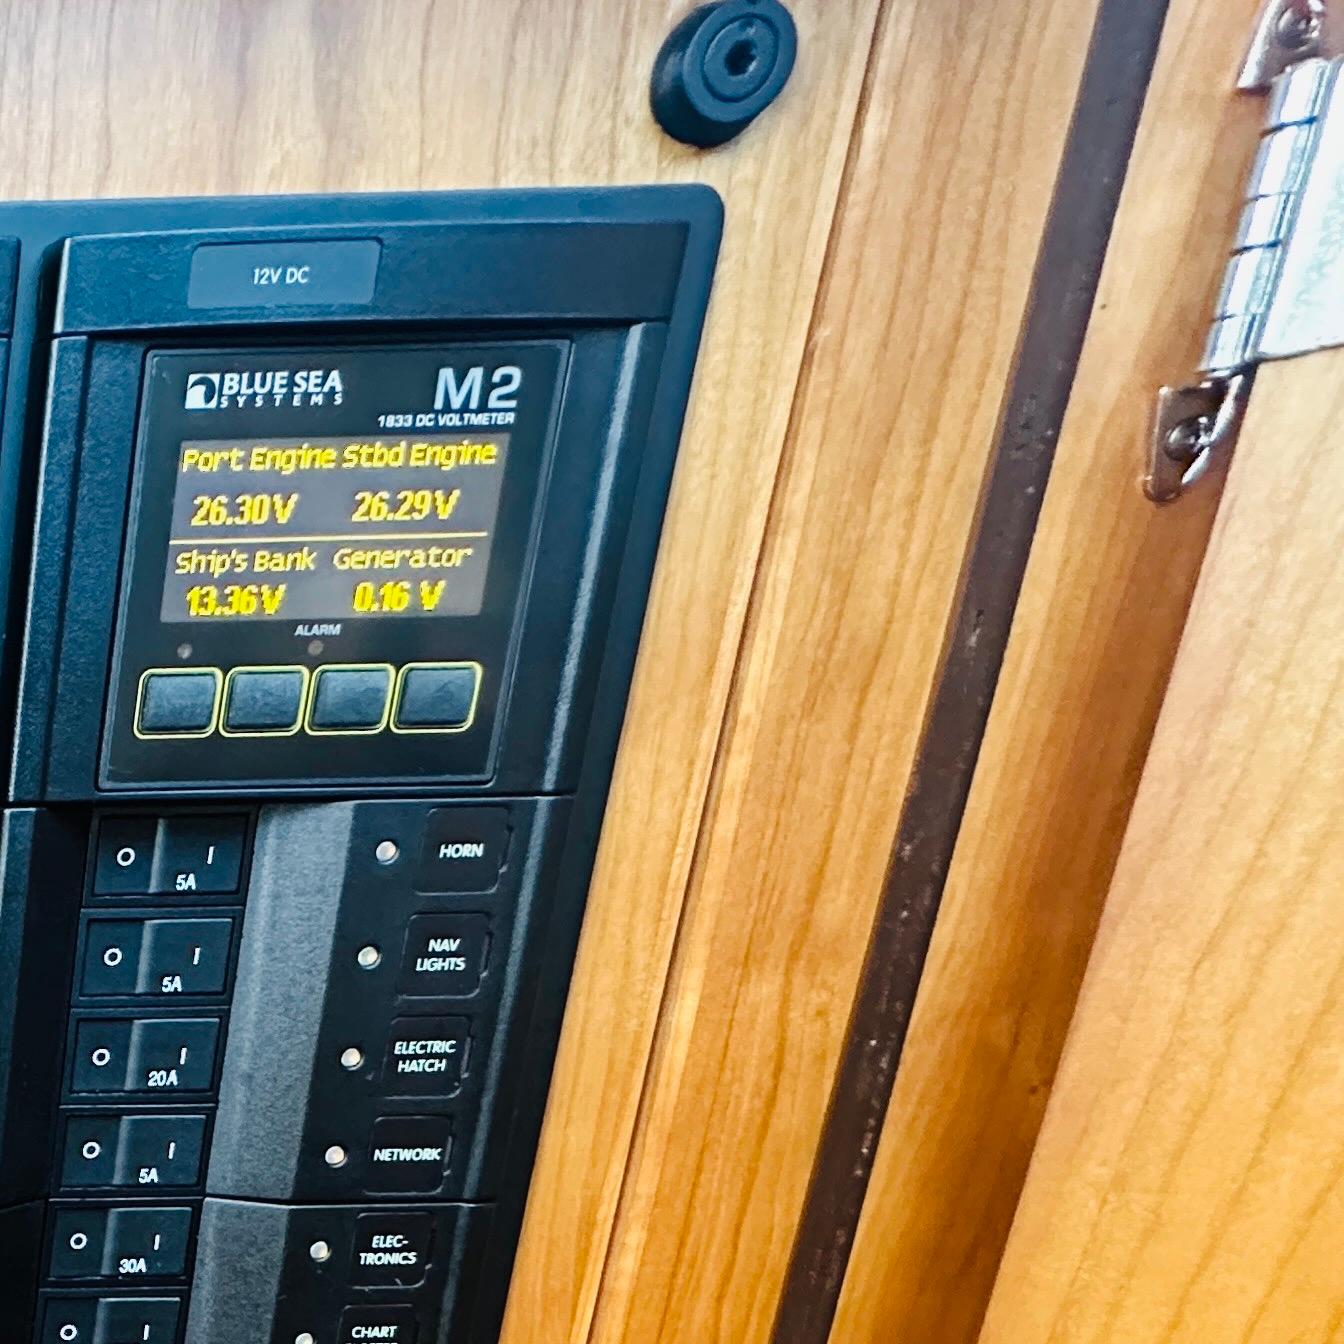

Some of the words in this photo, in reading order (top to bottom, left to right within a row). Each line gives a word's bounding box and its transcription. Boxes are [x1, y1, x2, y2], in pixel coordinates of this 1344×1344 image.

[252, 268, 282, 284] 12V
[286, 267, 309, 283] DC
[222, 373, 289, 394] BLUE
[294, 370, 342, 392] SEA
[219, 392, 343, 408] SYSTEMS
[377, 415, 413, 428] 1833
[415, 414, 434, 426] DC
[437, 412, 514, 426] VOLTMETER
[182, 447, 244, 472] Port
[249, 446, 337, 476] Engine
[342, 444, 406, 468] Stbd
[408, 442, 497, 469] Engine
[175, 550, 249, 577] Ship's
[254, 550, 315, 573] Bank
[333, 547, 472, 571] Generator
[353, 583, 411, 612] 0.16
[294, 624, 341, 637] ALARM
[439, 843, 484, 858] HORN
[428, 939, 460, 953] NAV
[416, 957, 466, 971] LIGHTS
[393, 1040, 456, 1055] ELECTRIC
[398, 1059, 446, 1073] HATCH
[148, 1071, 178, 1087] 20A
[373, 1147, 441, 1162] NETWORK
[372, 1235, 408, 1249] ELEC-
[119, 1258, 146, 1273] 30A
[358, 1252, 417, 1266] TRONICS
[351, 1326, 397, 1339] CHART
